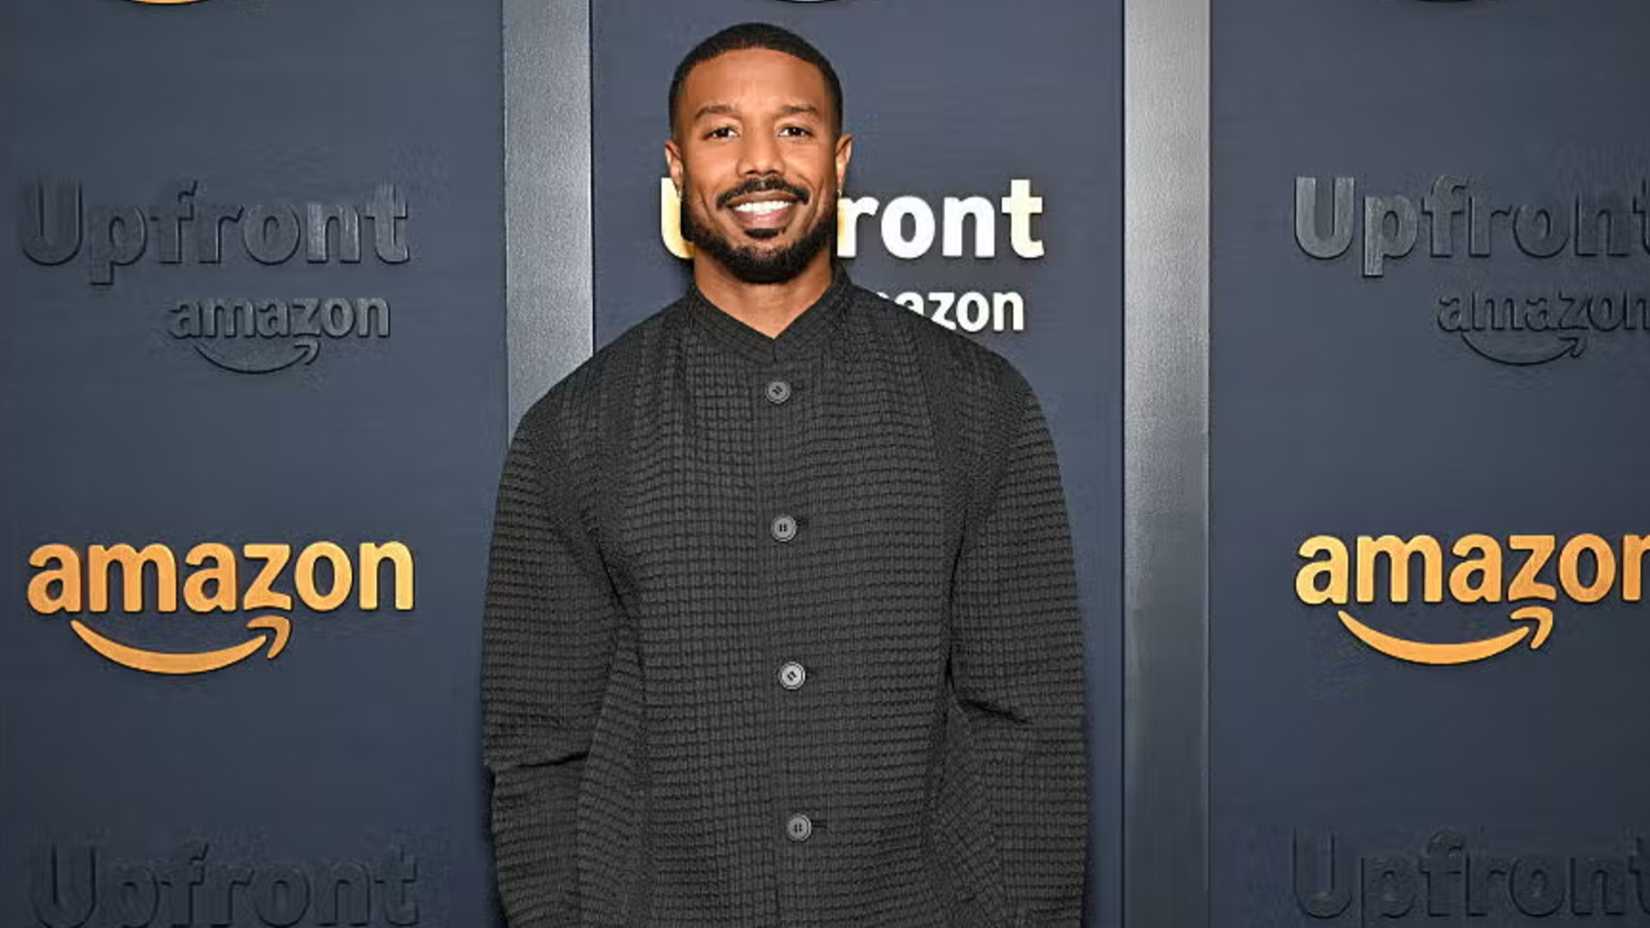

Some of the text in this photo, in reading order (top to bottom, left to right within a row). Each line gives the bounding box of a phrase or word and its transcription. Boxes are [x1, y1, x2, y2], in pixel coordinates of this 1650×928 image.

[19, 181, 409, 285] Upfront
[170, 297, 390, 338] amazon
[27, 541, 415, 614] amazon
